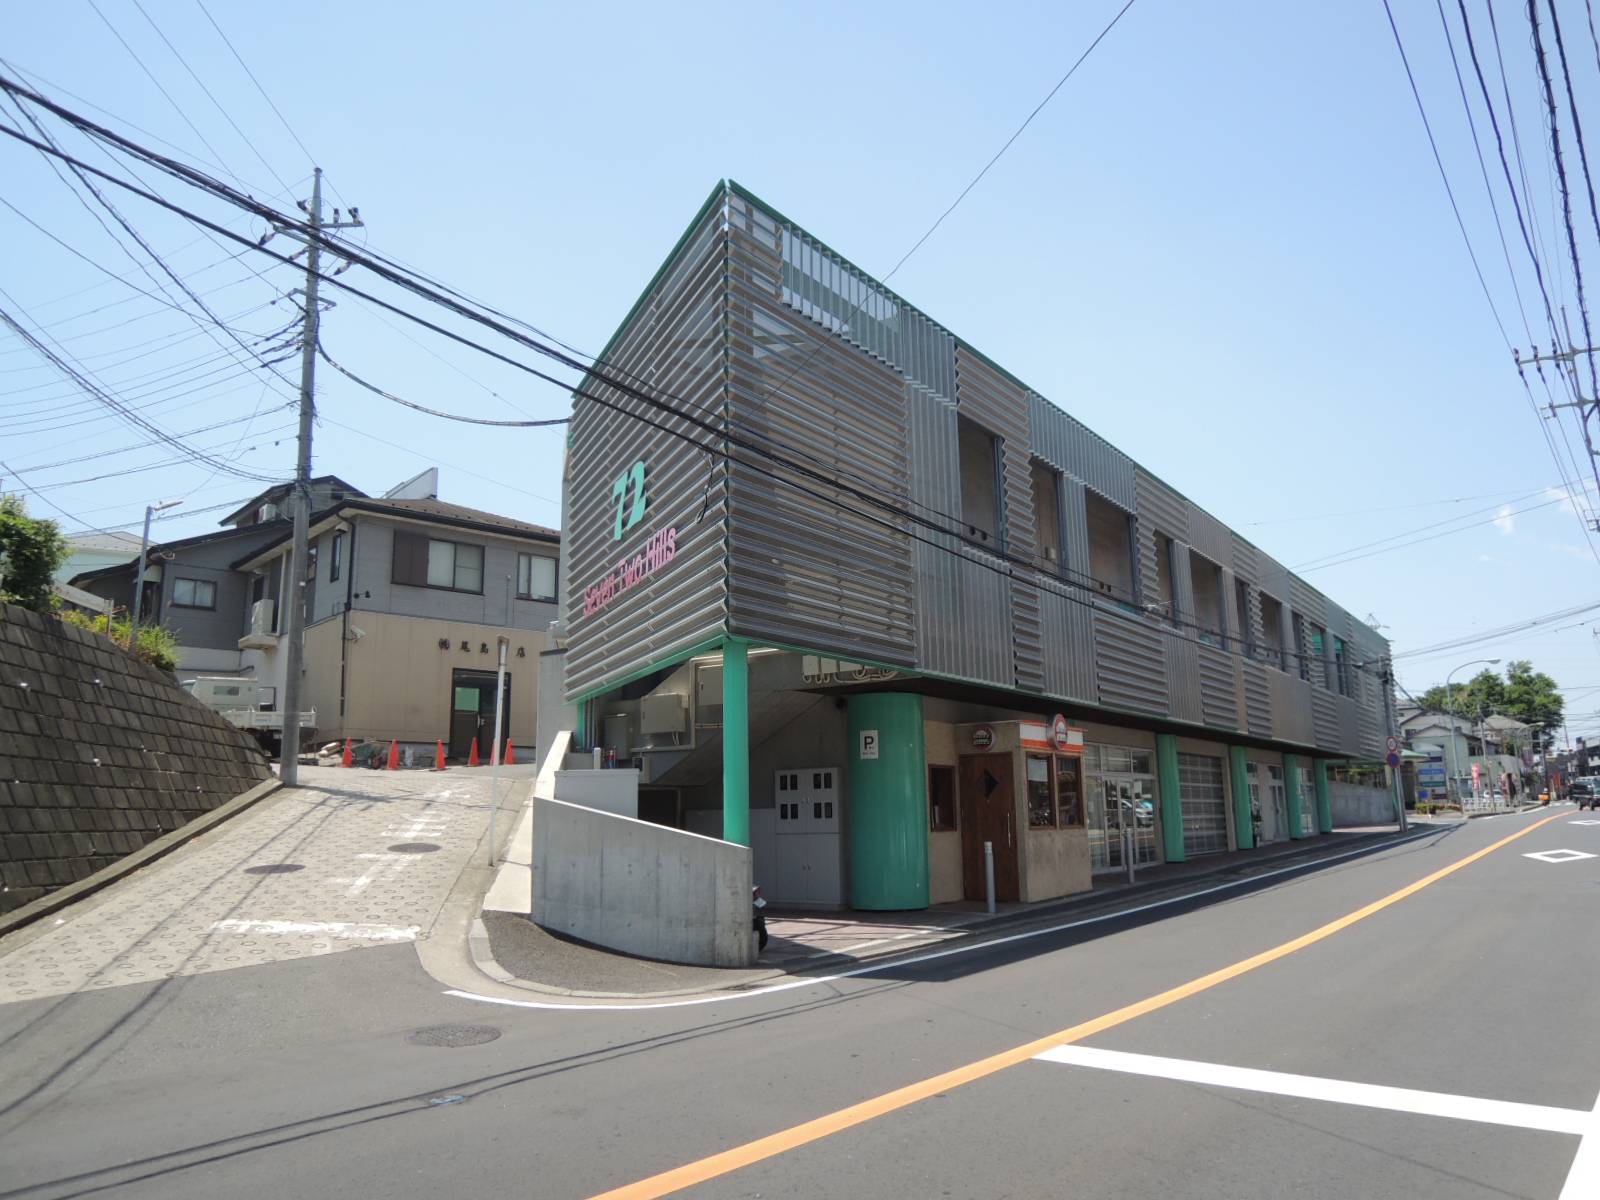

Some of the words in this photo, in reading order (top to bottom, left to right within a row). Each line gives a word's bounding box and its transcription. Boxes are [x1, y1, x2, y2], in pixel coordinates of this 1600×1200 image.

[611, 460, 646, 541] 72
[583, 573, 615, 618] Seven
[618, 554, 642, 592] Two
[646, 528, 676, 574] Hills
[864, 736, 874, 750] P
